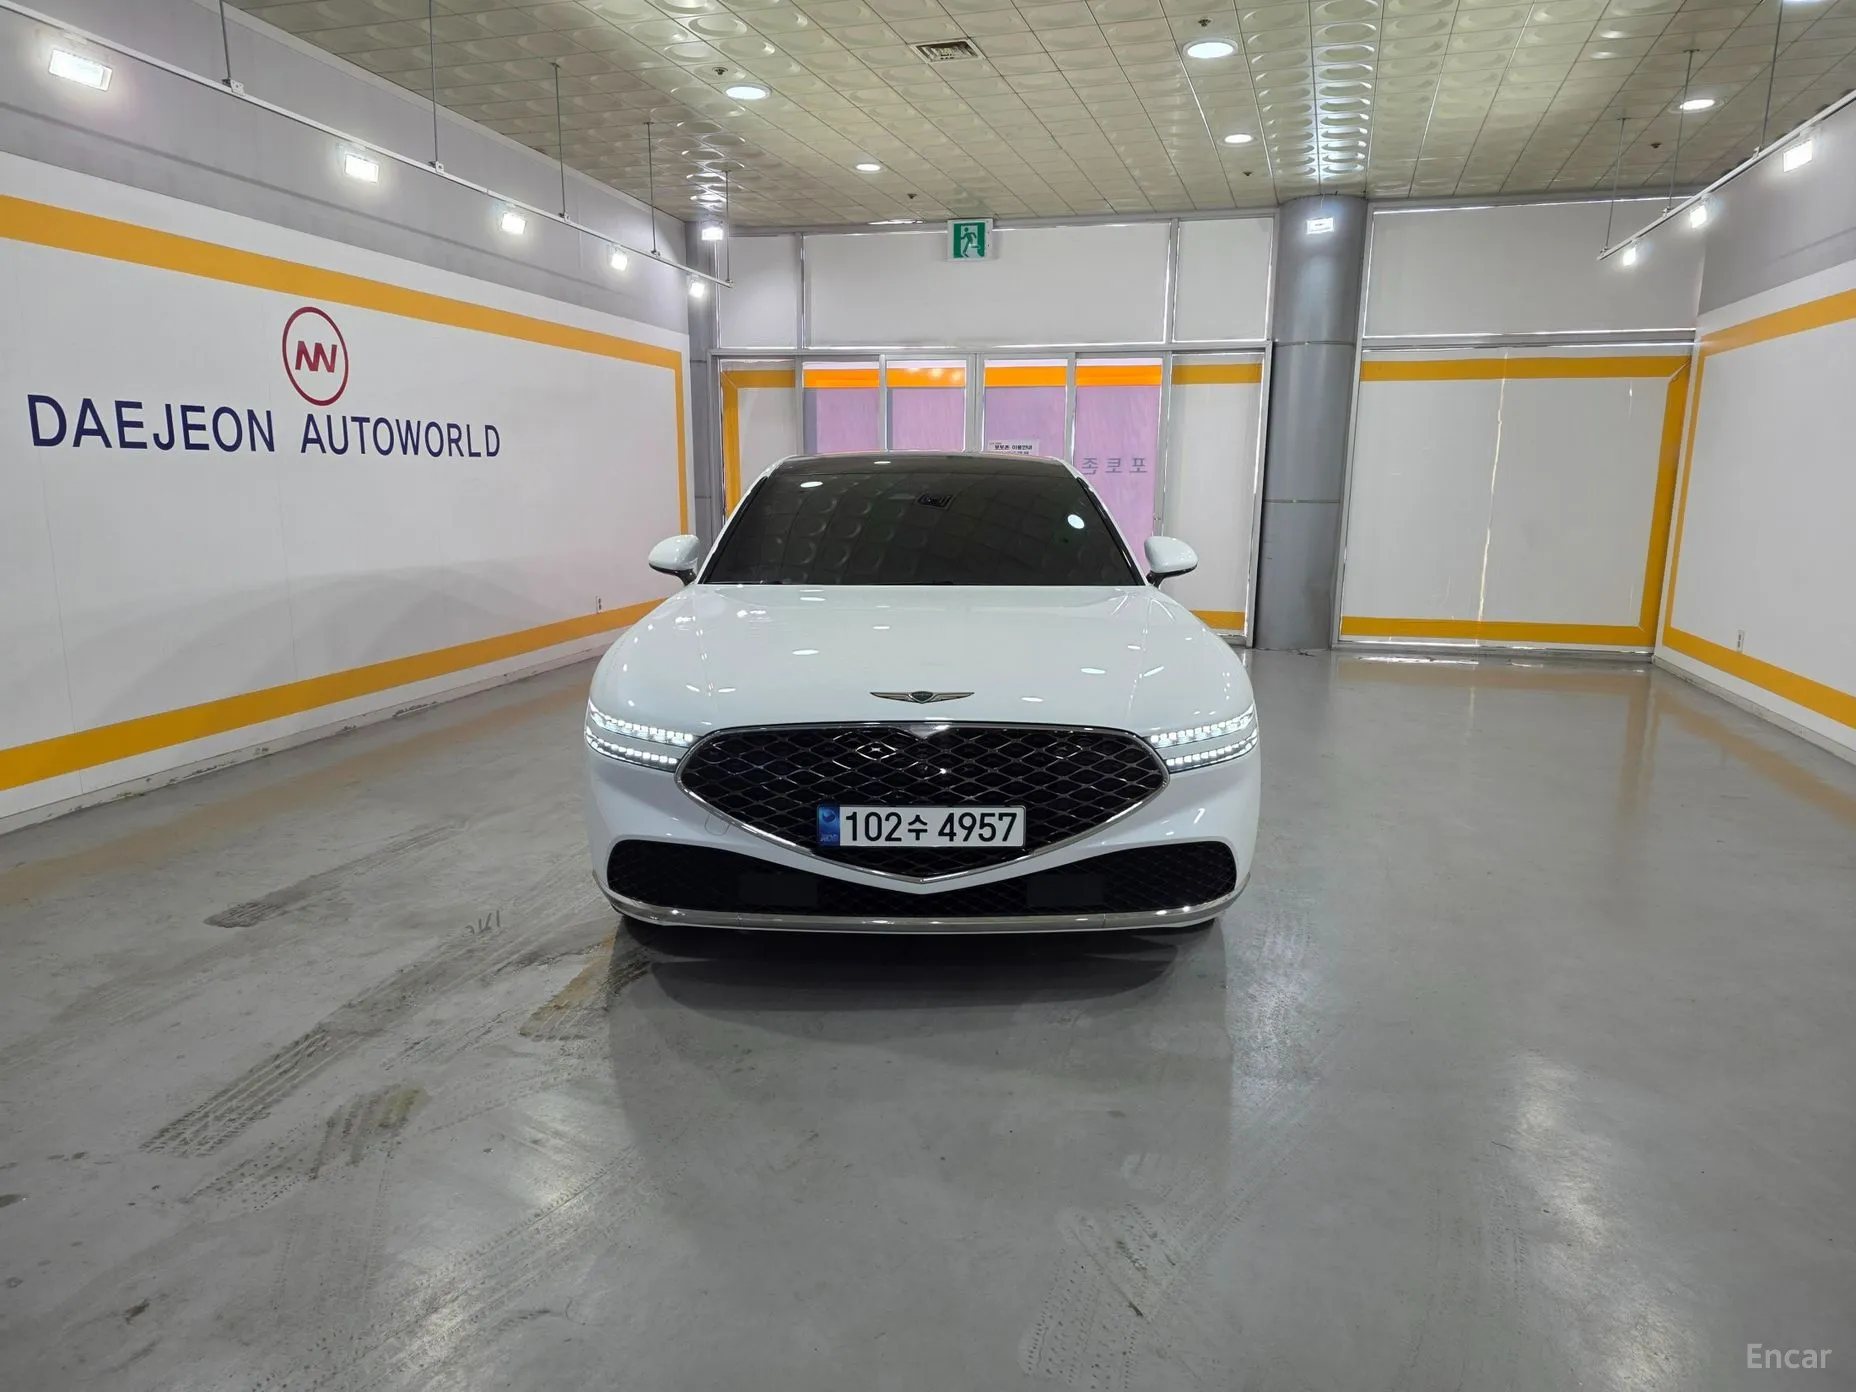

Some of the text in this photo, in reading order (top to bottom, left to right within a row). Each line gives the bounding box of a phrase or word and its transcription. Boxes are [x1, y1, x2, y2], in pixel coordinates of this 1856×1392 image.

[27, 394, 500, 458] DAEJEON AUTOWORLD
[845, 811, 1018, 842] 102수 4957
